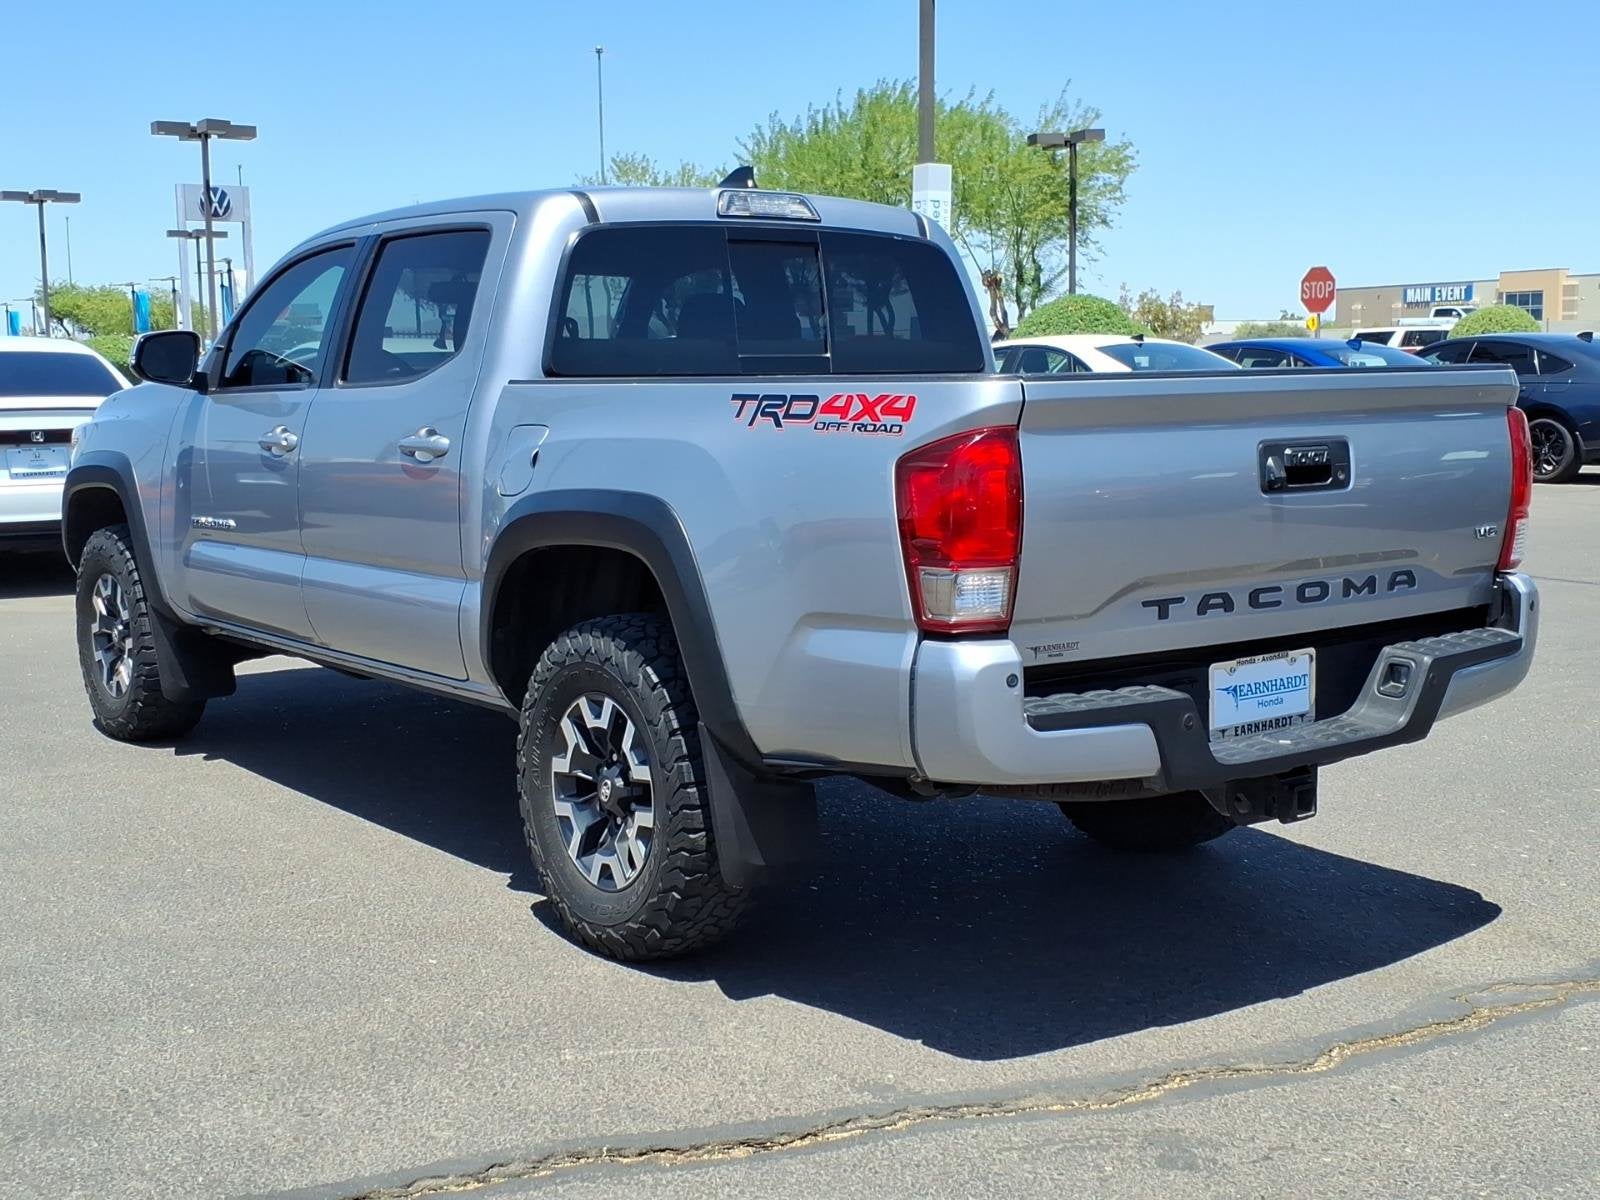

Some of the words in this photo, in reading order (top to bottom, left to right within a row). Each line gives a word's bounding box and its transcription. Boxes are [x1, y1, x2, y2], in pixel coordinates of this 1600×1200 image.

[1303, 281, 1333, 299] STOP
[1406, 287, 1431, 302] MAIN
[1435, 285, 1467, 302] EVENT
[730, 394, 820, 429] TRD
[813, 422, 848, 431] OFF
[851, 423, 903, 434] ROAD
[1141, 569, 1418, 620] TACOMA
[1038, 641, 1080, 652] EARNHARDT
[1236, 656, 1256, 667] Honda
[1238, 674, 1308, 697] EARNHARDT
[1257, 696, 1284, 708] Honda
[1234, 714, 1294, 737] EARNHARDT
